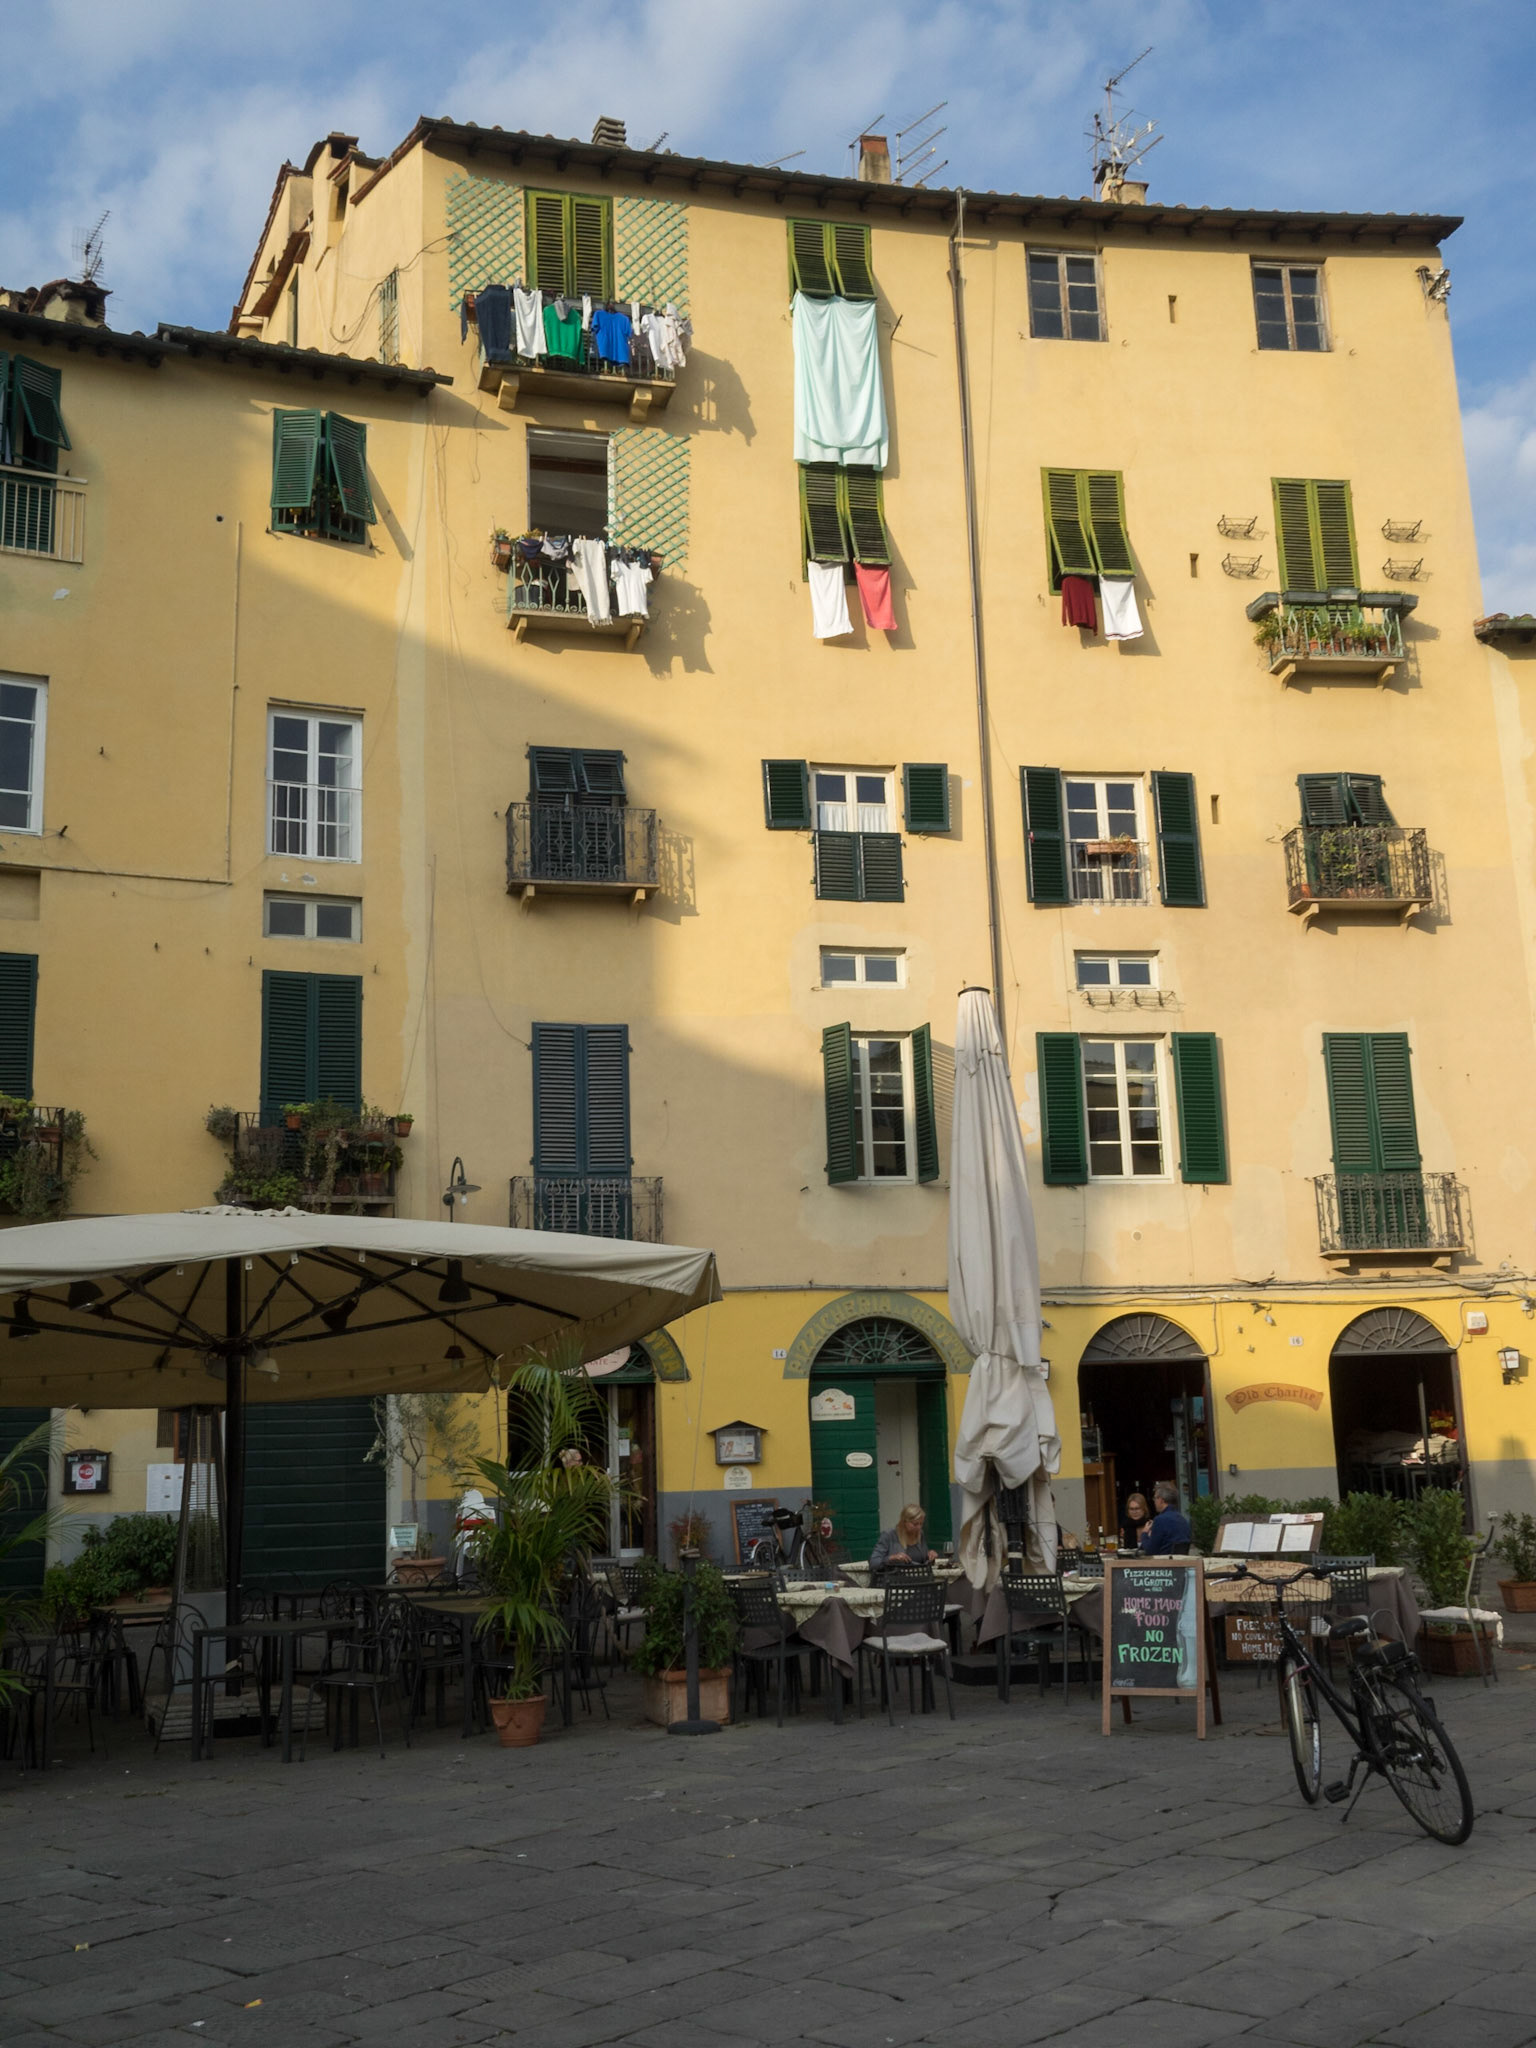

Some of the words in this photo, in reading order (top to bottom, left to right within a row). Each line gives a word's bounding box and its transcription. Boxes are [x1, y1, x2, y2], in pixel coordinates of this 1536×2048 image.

[1233, 1389, 1260, 1404] Old
[1263, 1386, 1317, 1401] Charlie
[1123, 1568, 1173, 1578] PIZZICHERIA
[1123, 1597, 1151, 1611] HOME
[1153, 1598, 1184, 1612] MADE
[1134, 1611, 1170, 1627] FOOD
[1144, 1630, 1164, 1643] NO
[1118, 1643, 1184, 1664] FROZEN
[1241, 1642, 1262, 1654] HOME
